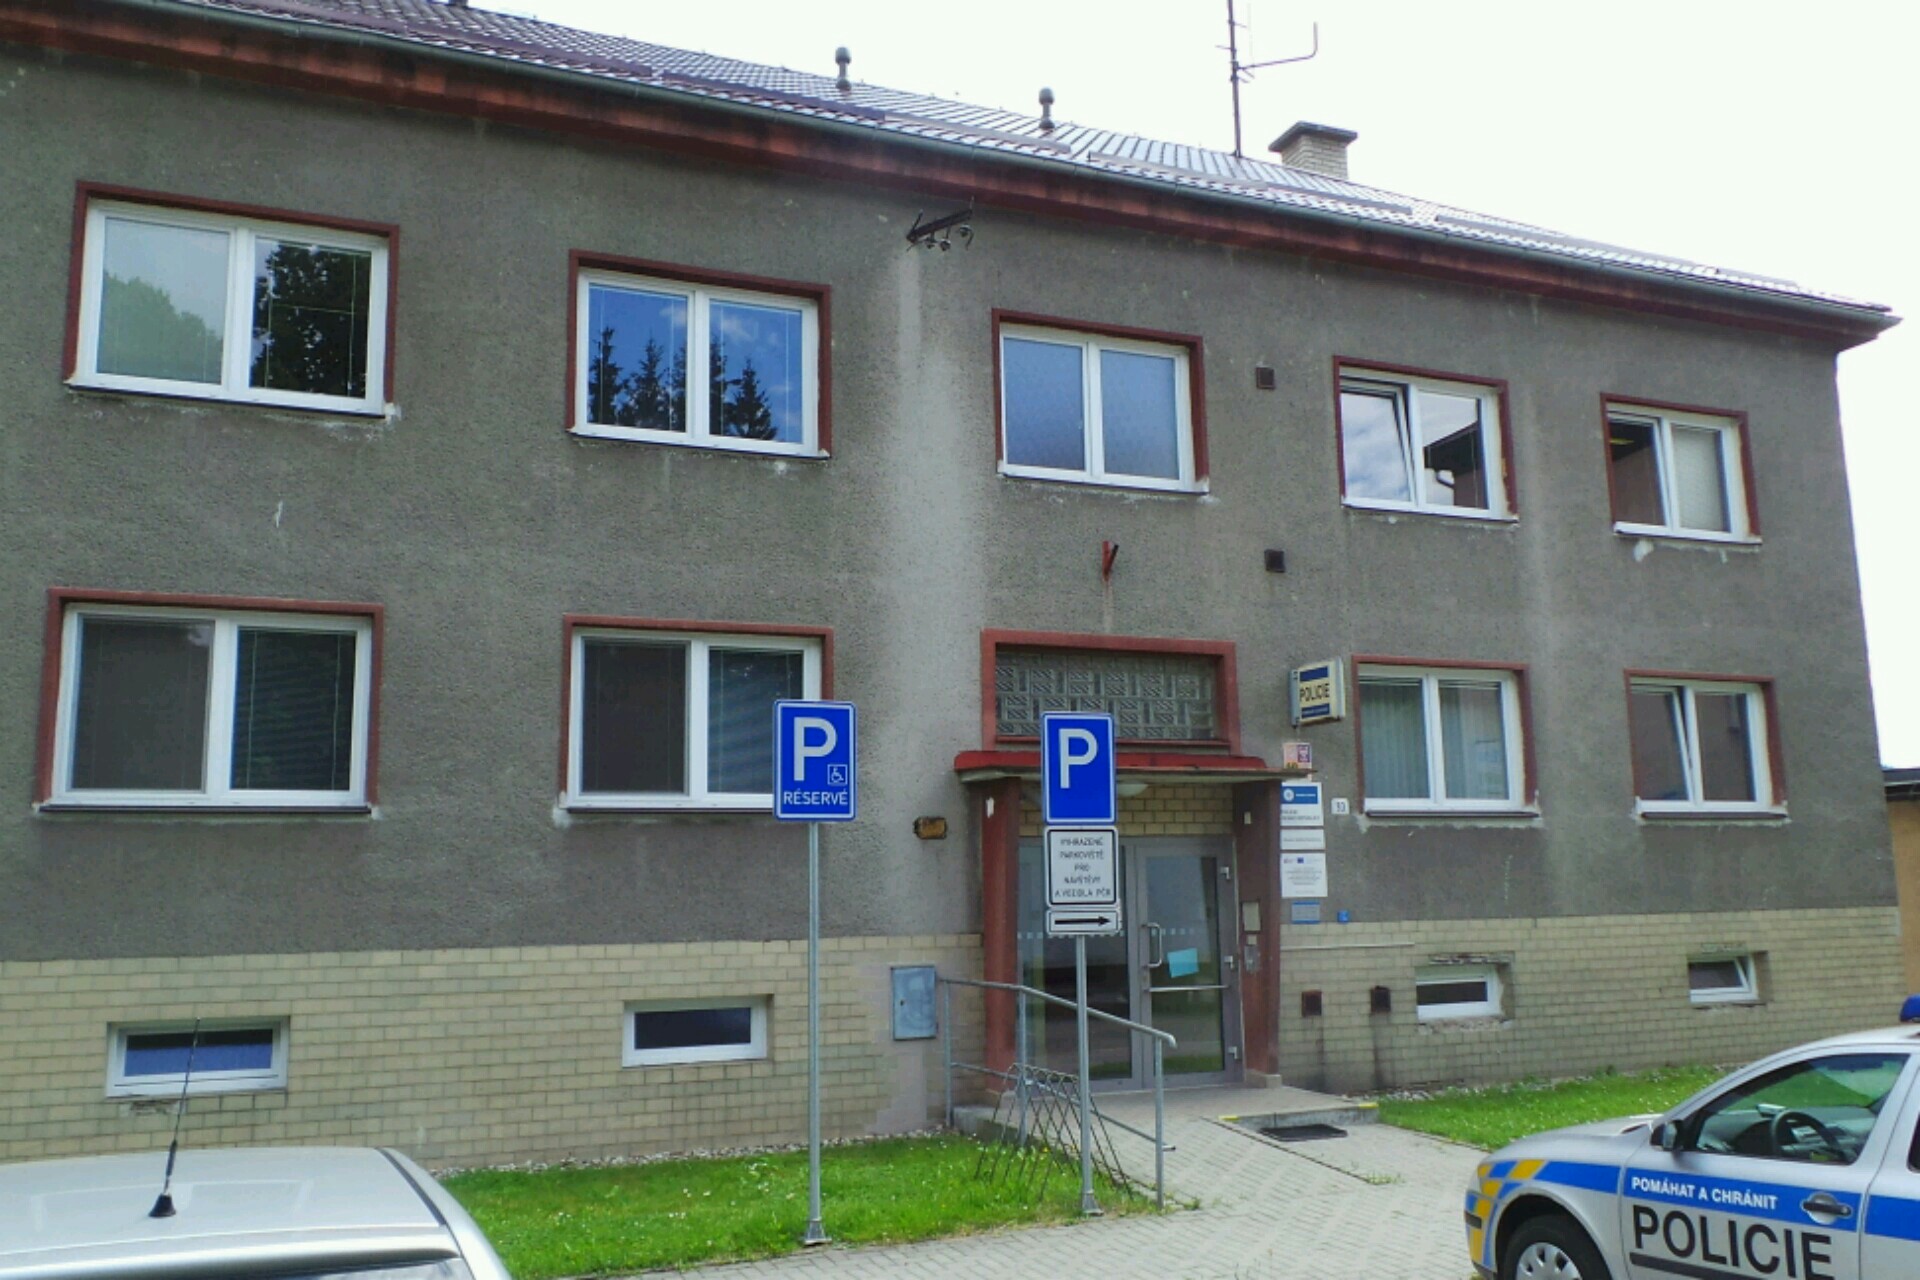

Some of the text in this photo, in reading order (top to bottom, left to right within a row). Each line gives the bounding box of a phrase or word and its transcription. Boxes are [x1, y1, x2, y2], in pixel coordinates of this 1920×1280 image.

[1299, 682, 1330, 702] POLICIE
[793, 716, 837, 781] P
[1058, 728, 1098, 789] P
[783, 788, 848, 806] RÉSERVÉ
[1632, 1176, 1778, 1210] POMÁHAT A CHRÁNIT
[1633, 1203, 1836, 1280] POLICIE
